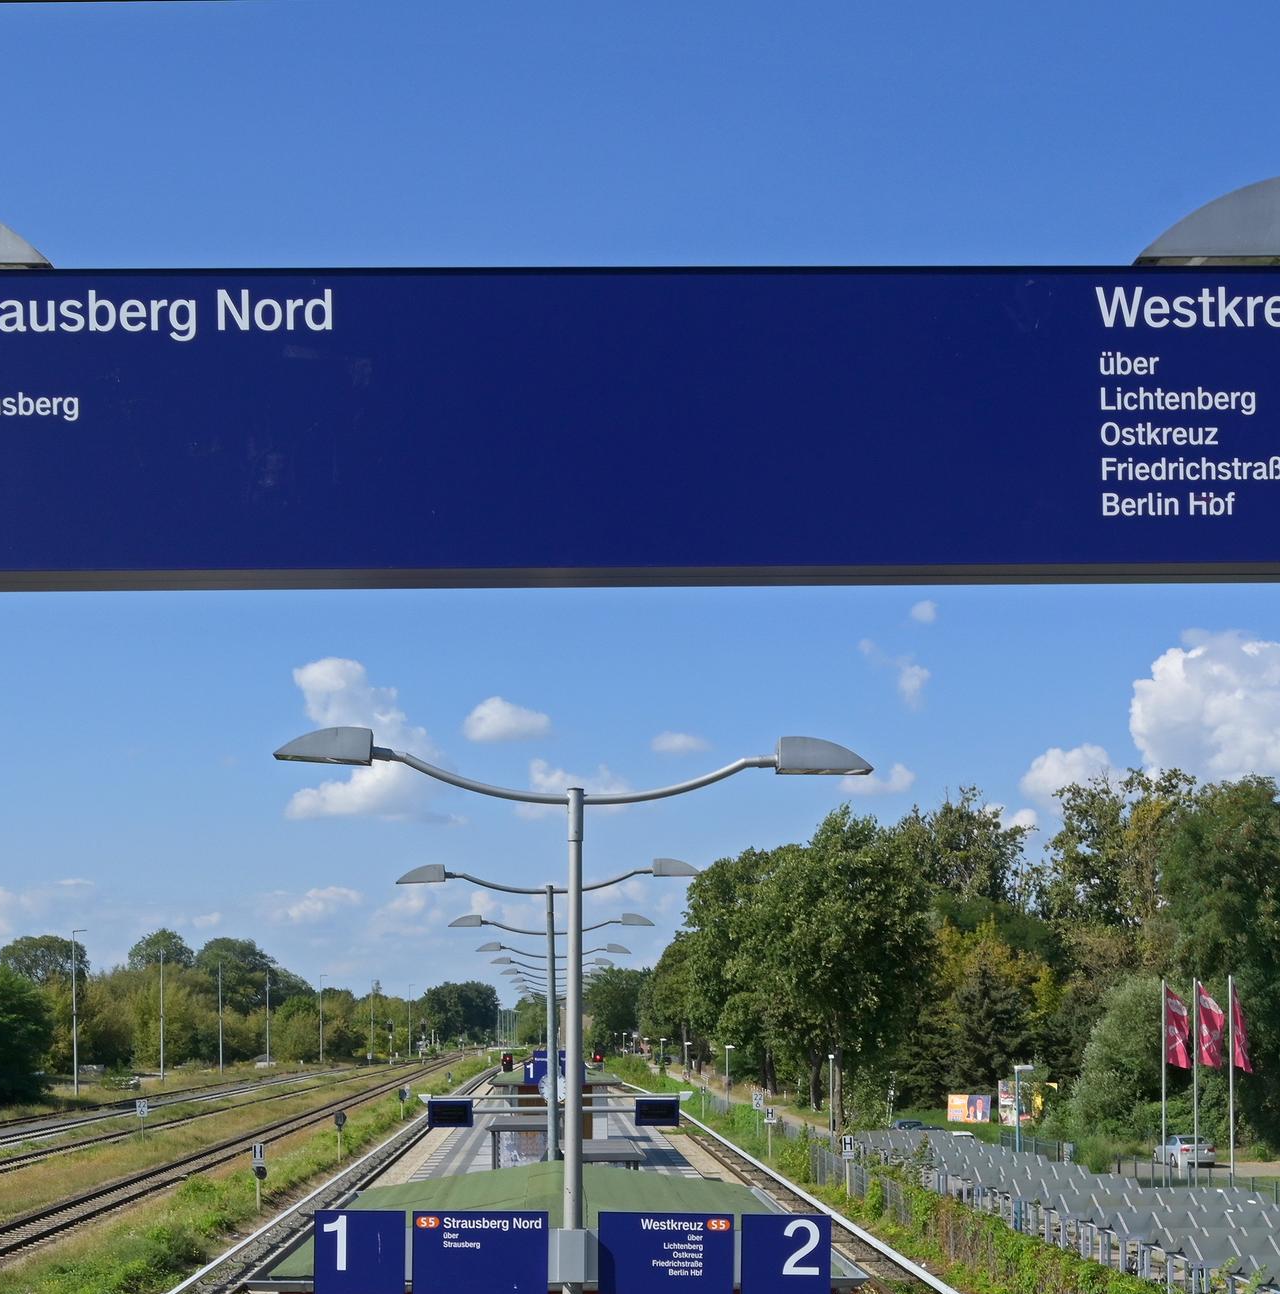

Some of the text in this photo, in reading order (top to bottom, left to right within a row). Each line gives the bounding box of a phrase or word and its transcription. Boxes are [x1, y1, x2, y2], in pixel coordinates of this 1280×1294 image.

[216, 287, 334, 332] Nord
[1098, 350, 1161, 377] über
[1099, 385, 1257, 417] Lichtenberg
[1099, 420, 1220, 447] Ostkreuz
[1101, 491, 1237, 518] Berlin Hbf
[525, 1062, 534, 1079] 1
[137, 1100, 147, 1108] 22
[753, 1093, 763, 1101] 22
[766, 1108, 774, 1119] H
[843, 1136, 853, 1151] H
[443, 1217, 510, 1232] Strausberg
[512, 1216, 543, 1230] Nord
[640, 1217, 705, 1232] Westkreuz
[322, 1214, 348, 1272] 1
[442, 1231, 460, 1240] über
[687, 1234, 704, 1242] über
[442, 1240, 482, 1250] Strausberg
[663, 1242, 705, 1252] Lichtenberg
[781, 1218, 821, 1277] 2
[672, 1251, 704, 1260] Ostkreuz
[651, 1259, 704, 1269] Friedrichstraße
[668, 1268, 704, 1278] Berlin Hbf
